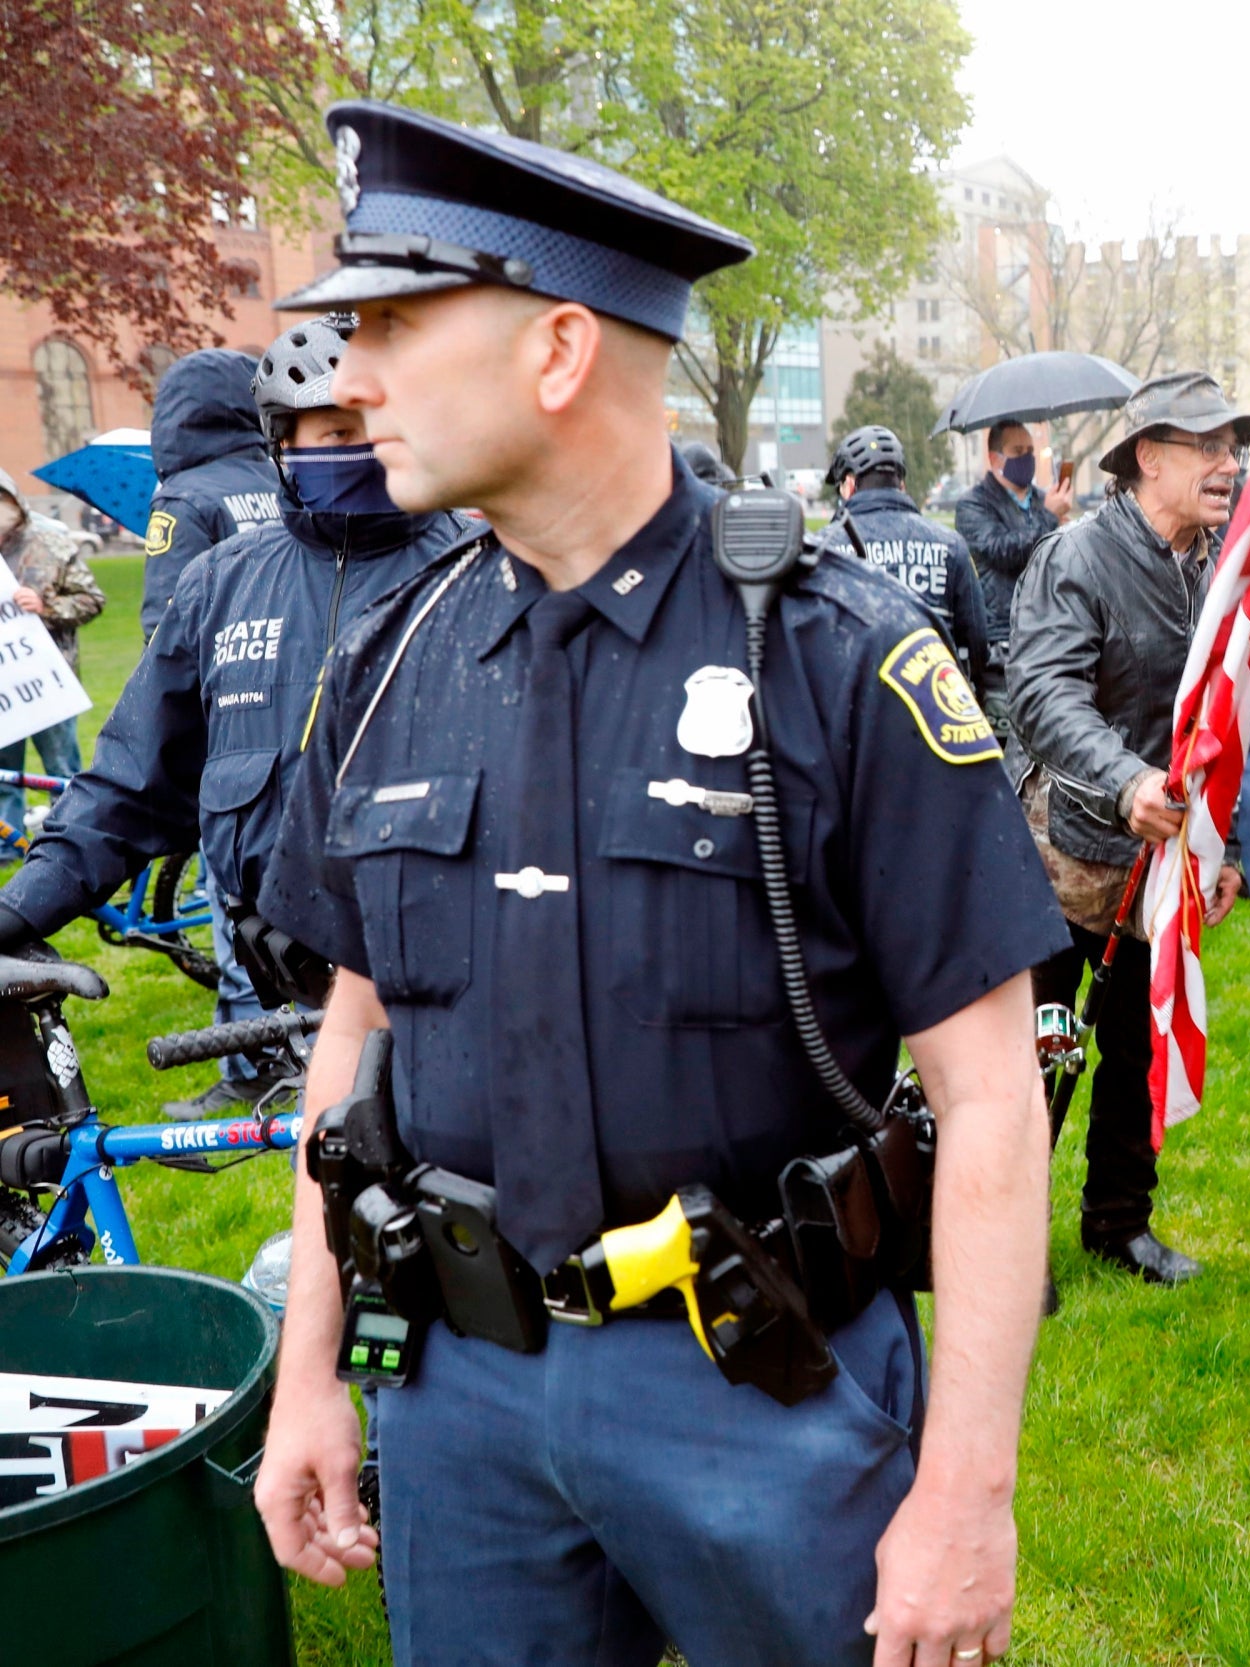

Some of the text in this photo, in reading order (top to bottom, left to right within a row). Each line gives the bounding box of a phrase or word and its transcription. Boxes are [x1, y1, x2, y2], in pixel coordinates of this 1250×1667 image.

[906, 541, 949, 566] STATE
[214, 617, 284, 645] STATE
[161, 1124, 220, 1150] STATE
